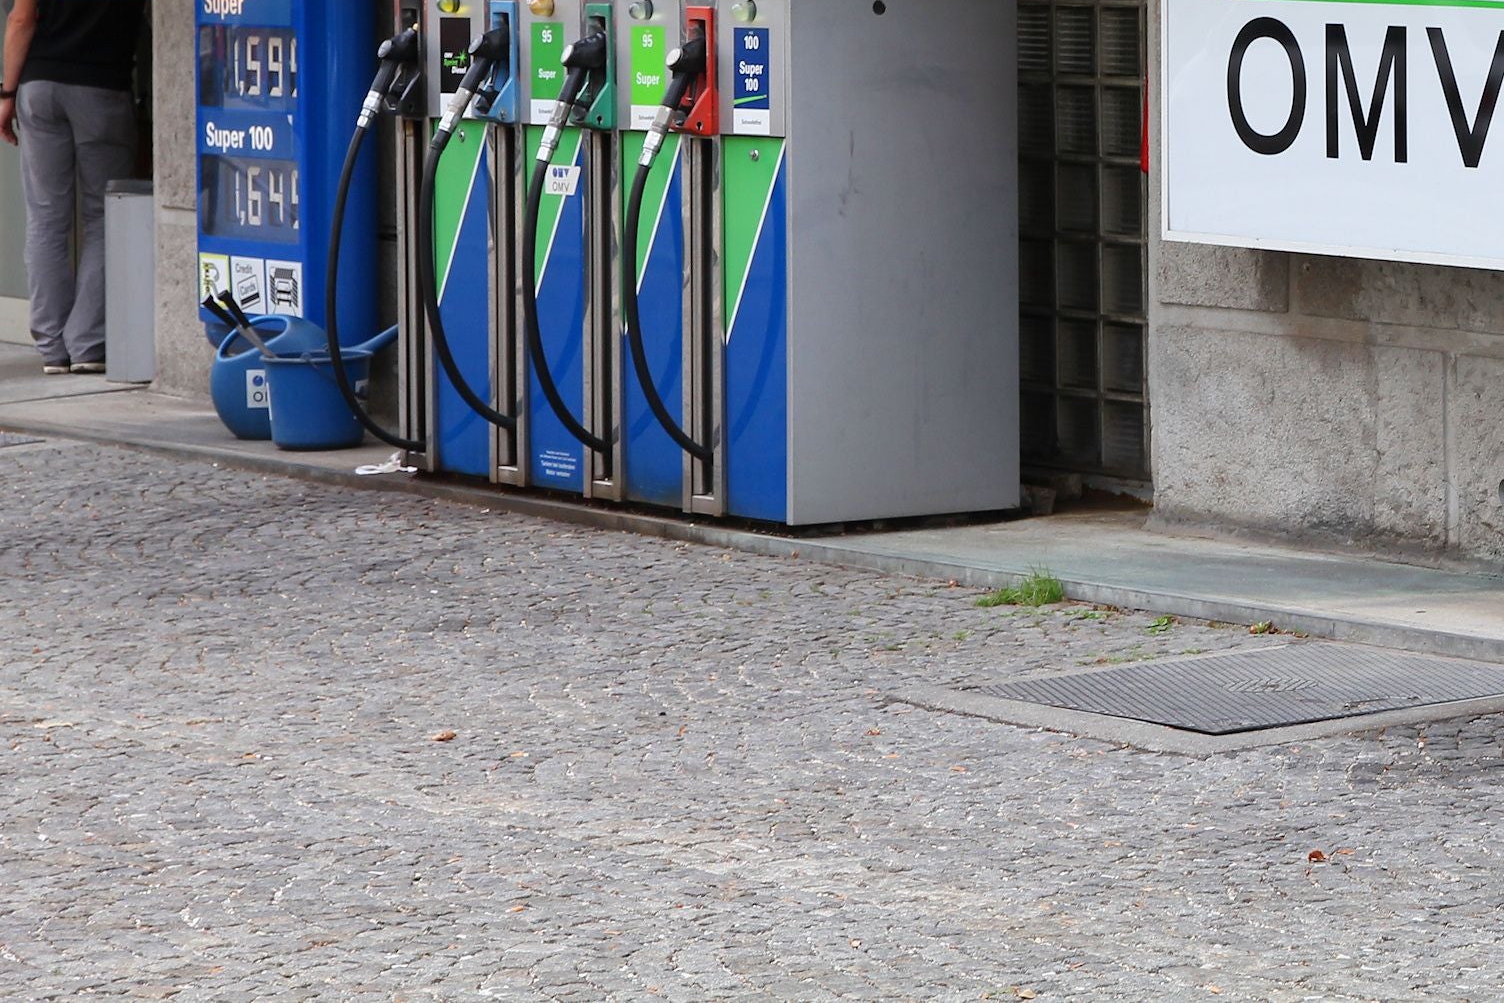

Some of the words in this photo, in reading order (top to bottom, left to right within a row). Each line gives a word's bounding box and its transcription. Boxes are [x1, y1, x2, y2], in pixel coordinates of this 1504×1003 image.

[542, 30, 552, 43] 95
[642, 34, 653, 48] 95
[744, 36, 759, 50] 100
[538, 68, 556, 80] Super
[739, 60, 764, 78] Super
[636, 72, 660, 88] Super
[744, 78, 759, 92] 100
[206, 122, 245, 153] Super
[248, 126, 274, 150] 100
[552, 182, 570, 192] OMV
